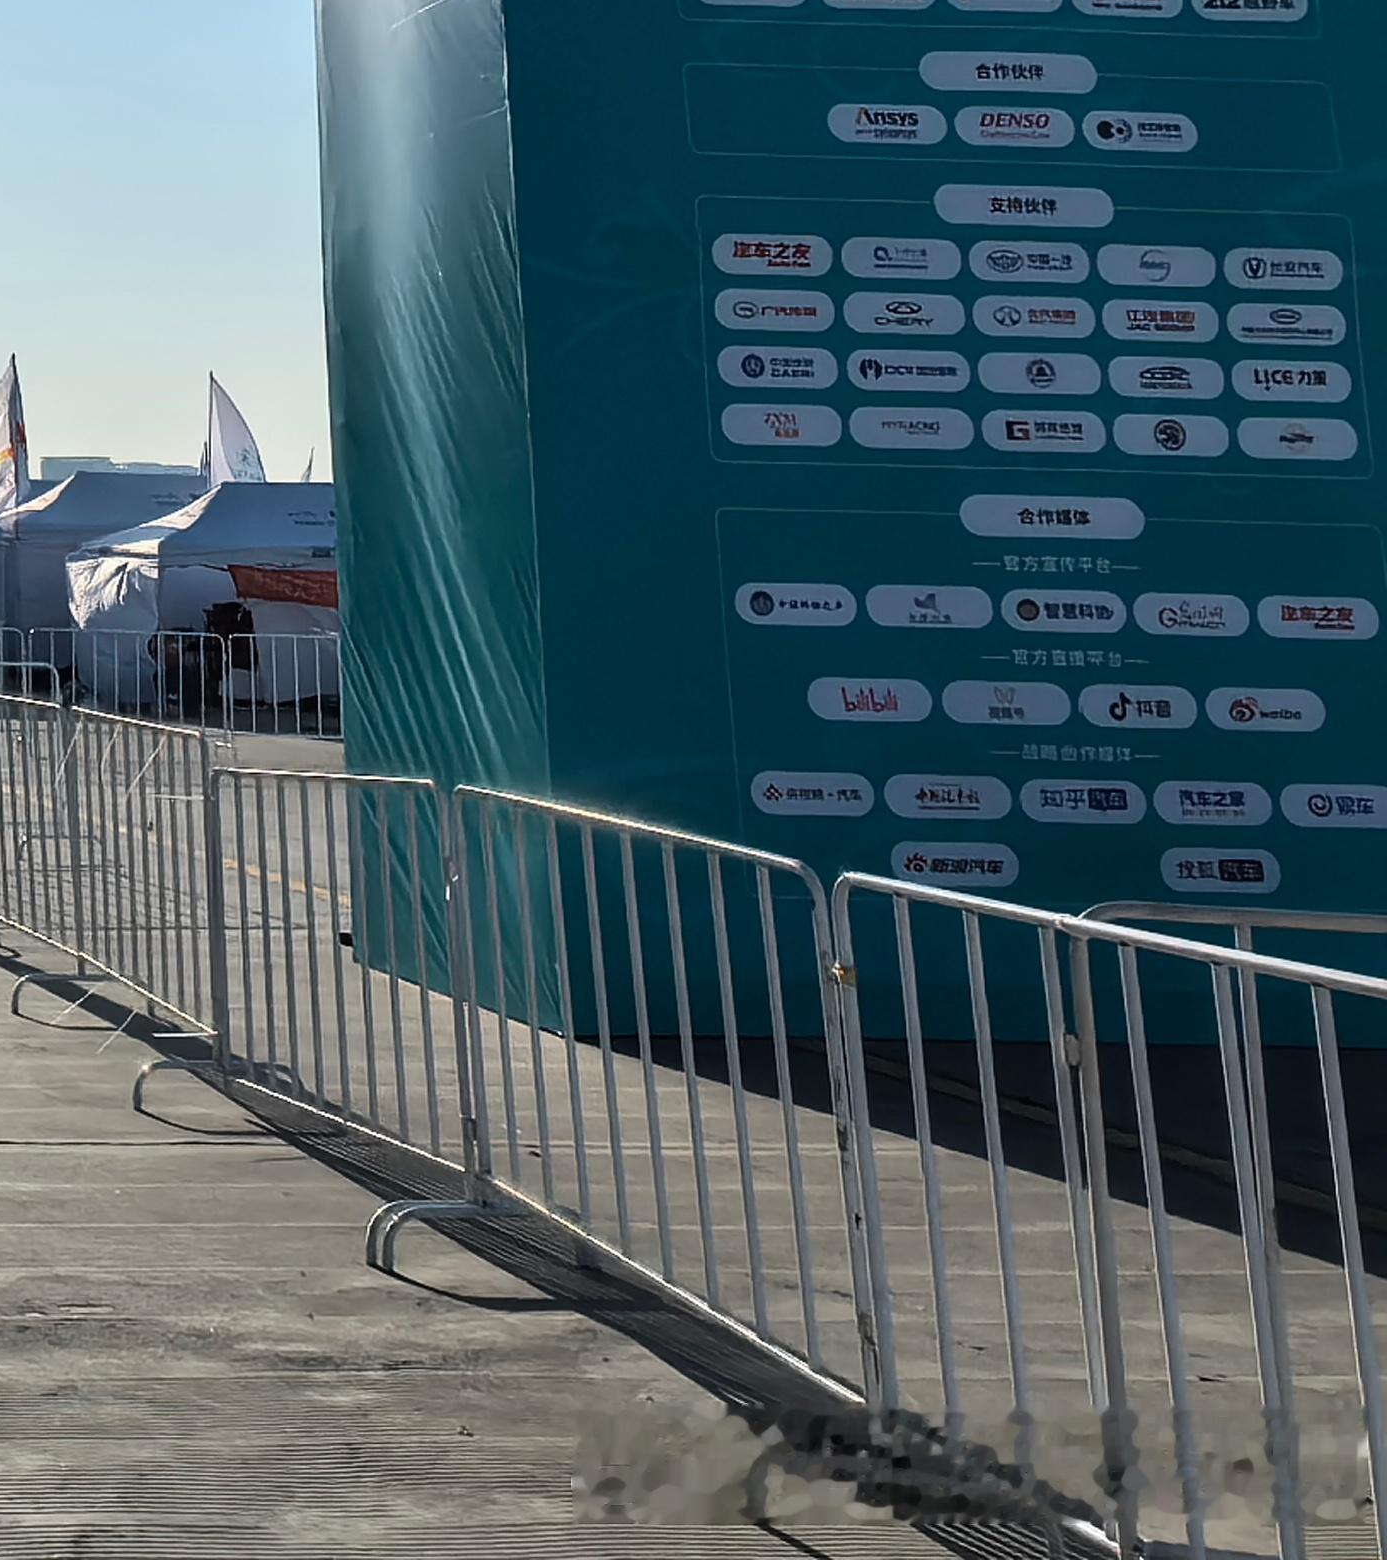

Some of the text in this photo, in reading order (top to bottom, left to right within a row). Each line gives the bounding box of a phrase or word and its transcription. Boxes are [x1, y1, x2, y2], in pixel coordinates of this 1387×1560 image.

[975, 63, 1045, 81] 合作伙伴
[855, 107, 920, 127] Ansys
[979, 112, 1051, 129] DENSO
[989, 197, 1058, 217] 支持伙伴
[1017, 507, 1091, 526] 合作媒体
[1002, 555, 1112, 574] 官方宣传平台
[1012, 648, 1123, 668] 官方直播平台
[841, 686, 898, 712] bilibili
[1136, 699, 1172, 719] 抖音
[1260, 708, 1302, 720] weibo
